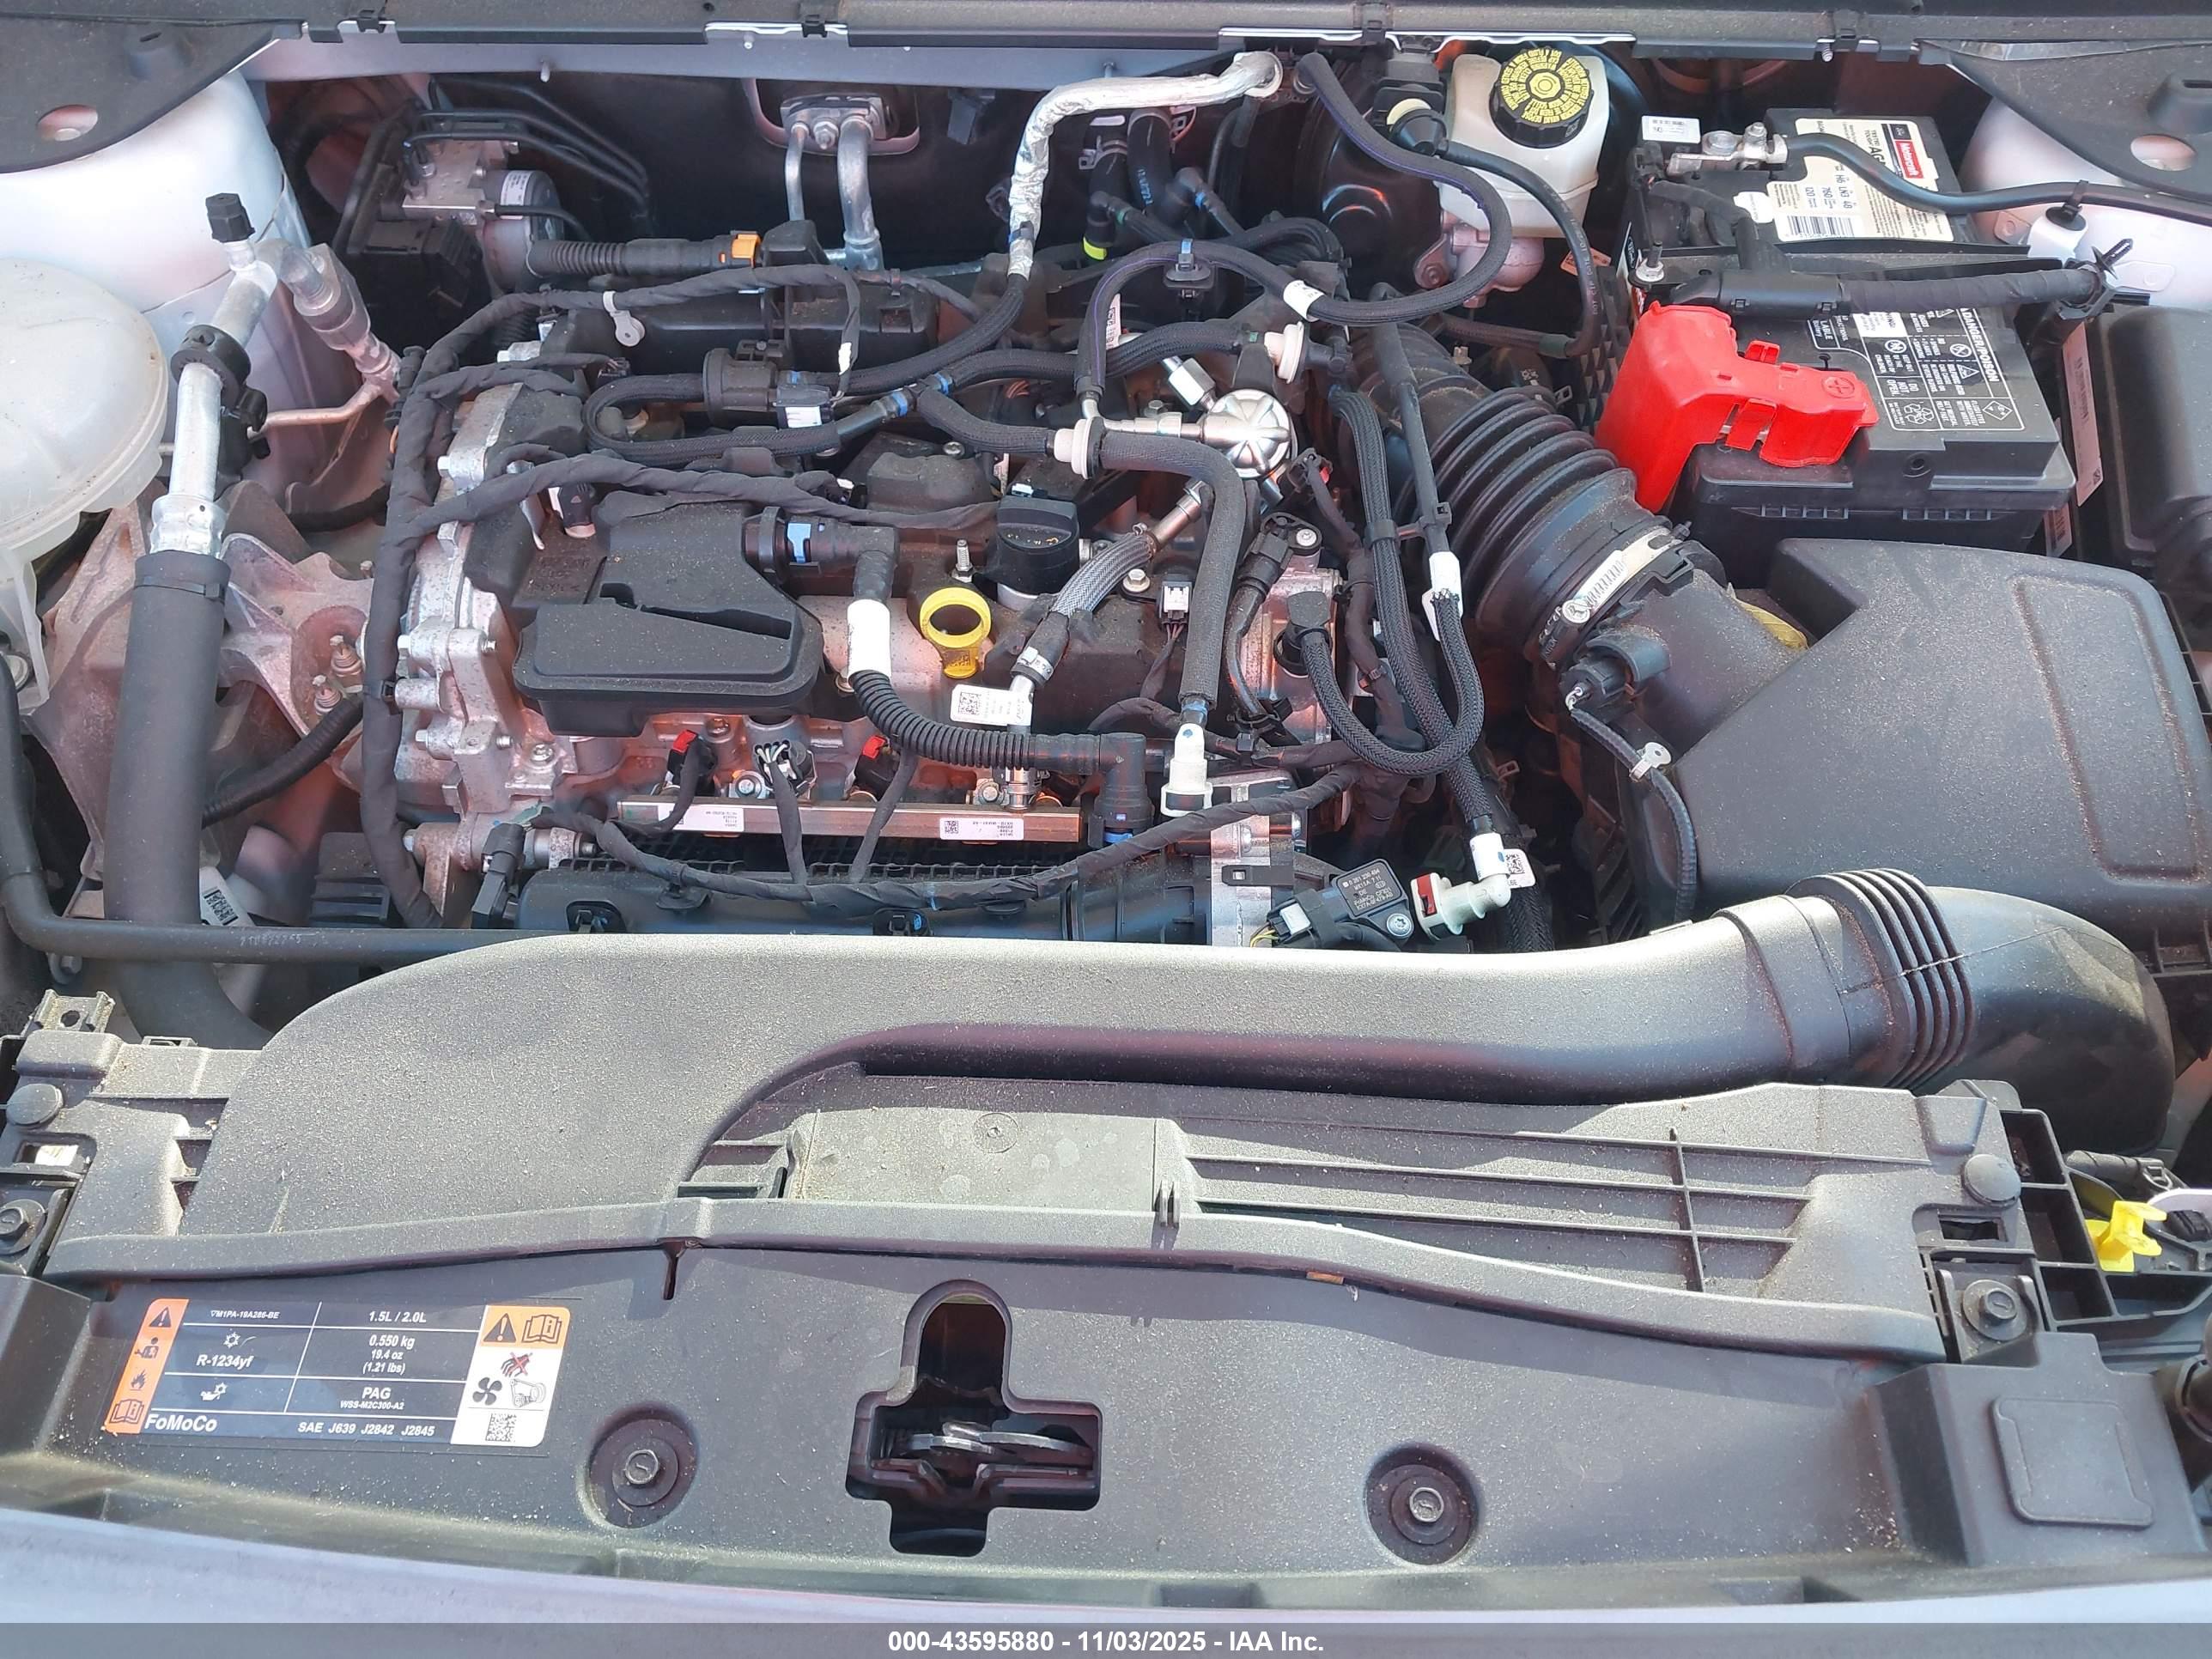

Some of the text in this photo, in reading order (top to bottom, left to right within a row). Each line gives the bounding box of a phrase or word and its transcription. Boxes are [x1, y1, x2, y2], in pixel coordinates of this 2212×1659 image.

[1899, 142, 1919, 177] Motorcraft
[1836, 174, 1844, 183] H6
[1806, 187, 1816, 198] 120
[1822, 187, 1832, 198] 760
[1838, 186, 1850, 198] LN3
[1843, 200, 1853, 209] 48
[1962, 312, 2000, 382] DANGER/POISON
[1897, 381, 1910, 393] NOT
[1908, 383, 1919, 392] DO
[368, 1311, 427, 1322] 1.5L / 2.0L
[369, 1334, 415, 1349] 0.550 kg
[371, 1350, 404, 1360] 19.4 oz
[196, 1354, 254, 1370] R-1234yf
[362, 1362, 406, 1375] (1.21 lbs)
[362, 1387, 391, 1399] PAG
[340, 1401, 404, 1410] WSS-M2C300-A2
[144, 1414, 218, 1432] FoMoCo
[298, 1422, 435, 1436] SAE J639 J2842 J2845
